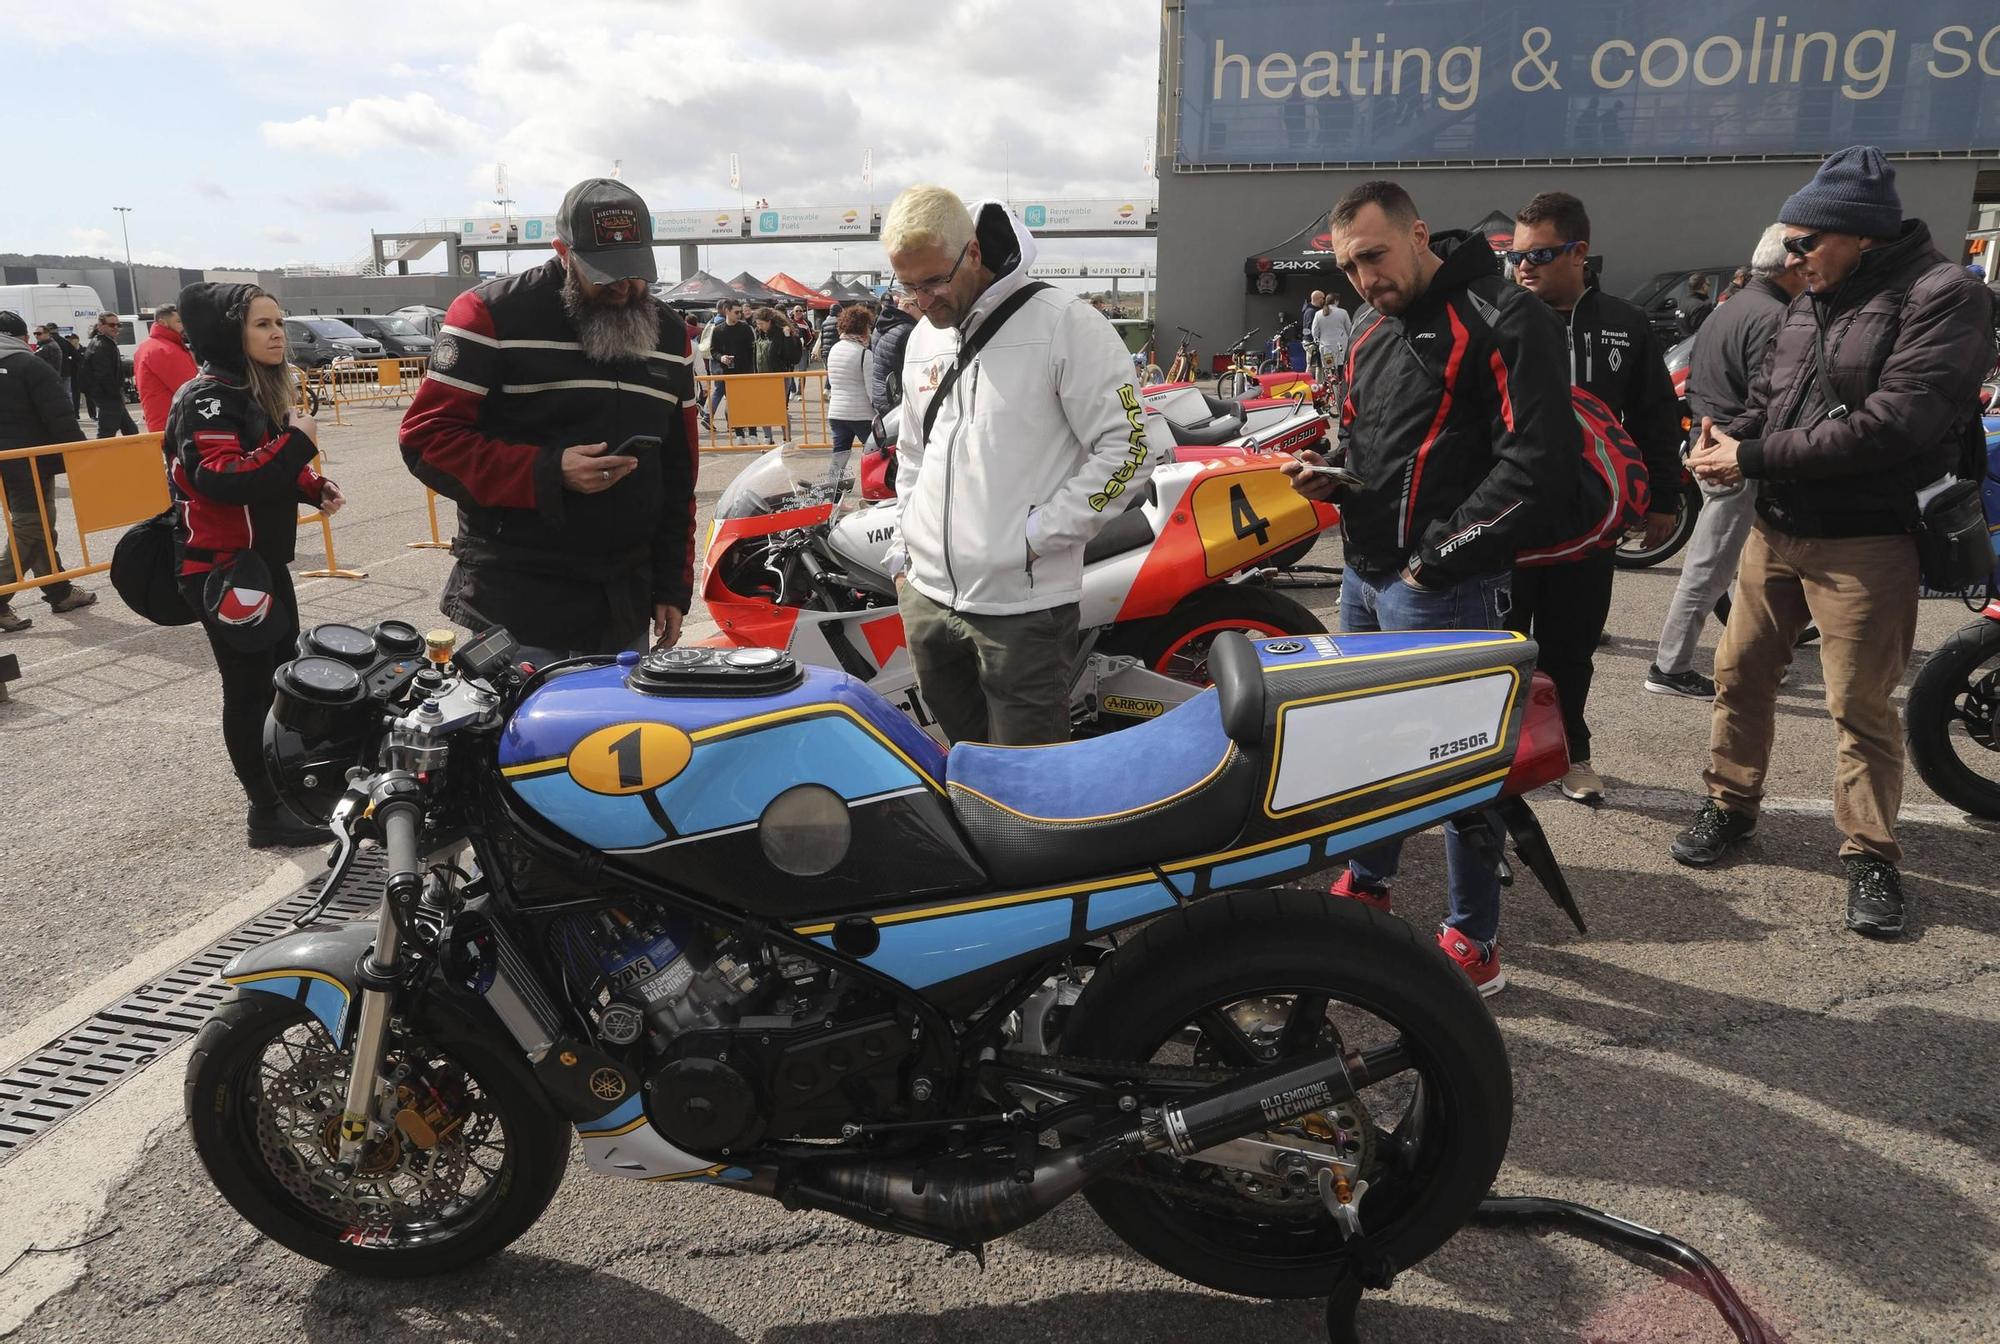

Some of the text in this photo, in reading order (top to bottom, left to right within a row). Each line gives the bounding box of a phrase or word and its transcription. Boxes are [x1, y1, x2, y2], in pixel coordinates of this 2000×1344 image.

[1212, 33, 1482, 112] heating
[1512, 26, 1564, 92] &
[1590, 18, 1897, 101] cooling
[781, 213, 819, 222] Renewable
[1050, 207, 1092, 215] Renewable
[658, 217, 701, 226] Combustibles
[781, 223, 800, 231] Fuels
[658, 225, 695, 233] Renovables
[1272, 261, 1321, 270] 24MX
[1601, 329, 1628, 338] Renault
[1610, 339, 1631, 347] Turbo
[1149, 394, 1167, 402] YAMAHA
[1230, 483, 1271, 546] 4
[867, 527, 895, 544] YAM
[1107, 698, 1158, 712] ARROW
[1429, 731, 1489, 760] RZ350R
[608, 727, 644, 788] 1
[640, 958, 687, 994] OLD SMOKING
[645, 965, 694, 1003] MACHINES
[1260, 1081, 1328, 1110] OLD SMOKING
[1263, 1092, 1334, 1123] MACHINES
